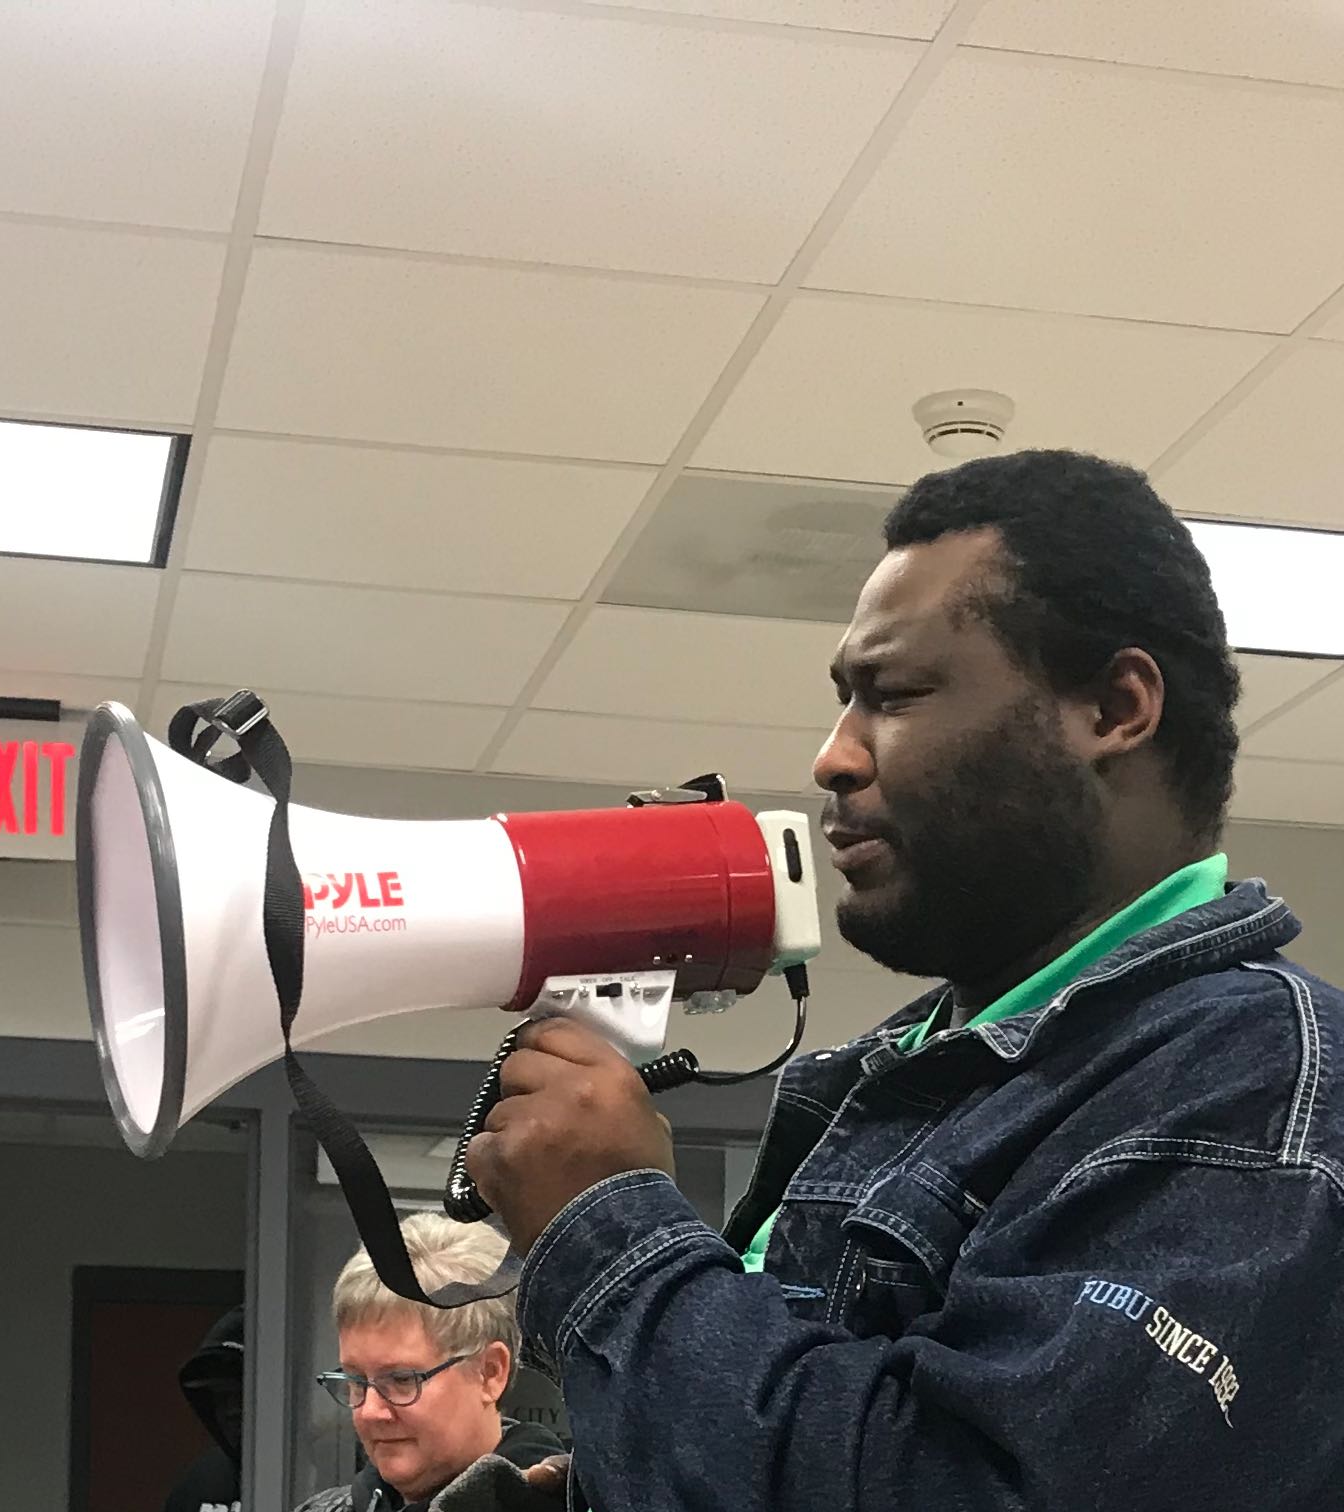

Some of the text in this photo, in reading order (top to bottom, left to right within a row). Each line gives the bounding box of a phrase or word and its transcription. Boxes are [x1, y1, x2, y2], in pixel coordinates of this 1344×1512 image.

[304, 871, 404, 910] PYLE
[306, 915, 407, 939] PyleUSA.com
[1074, 1279, 1154, 1321] FUBU
[1144, 1306, 1219, 1375] SINCE
